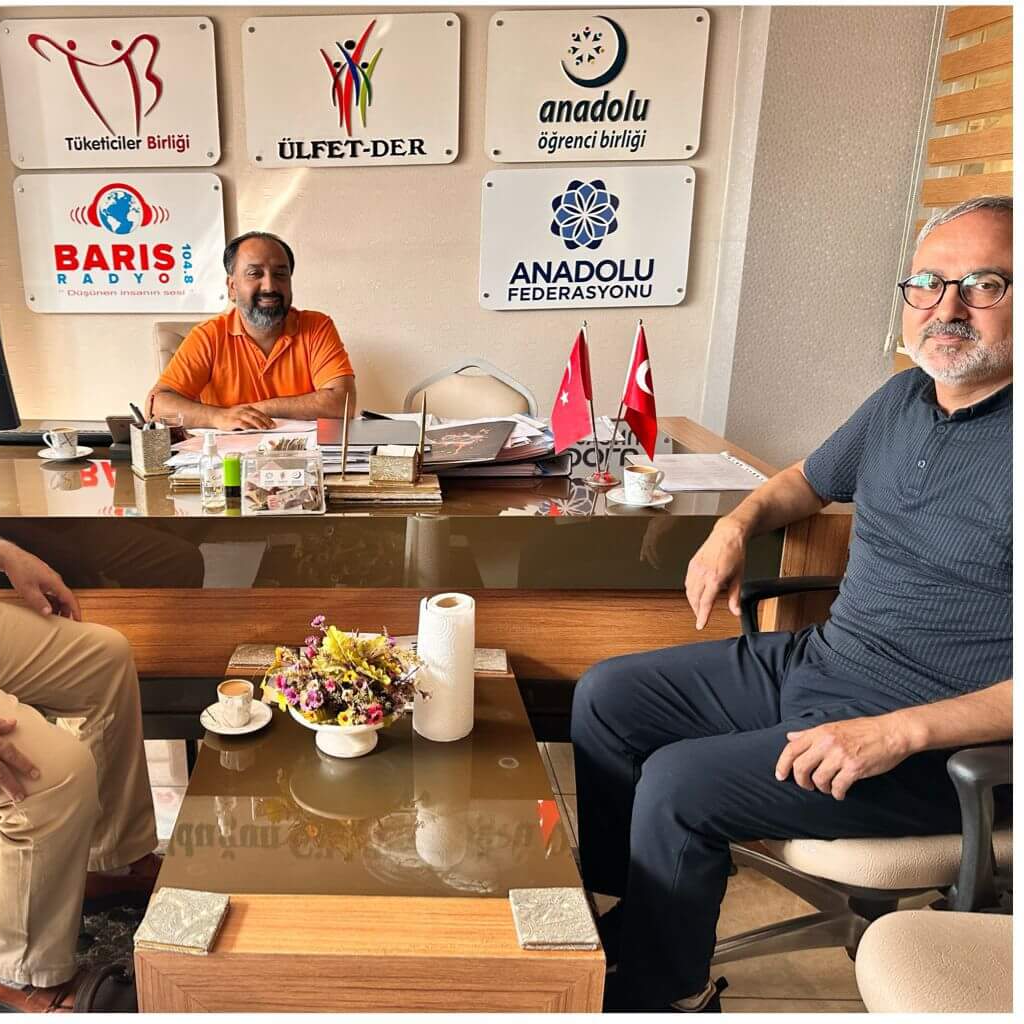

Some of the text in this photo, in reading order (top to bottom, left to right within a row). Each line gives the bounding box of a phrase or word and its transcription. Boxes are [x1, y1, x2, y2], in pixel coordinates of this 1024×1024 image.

[539, 90, 650, 122] anadolu
[65, 134, 190, 153] Tüketiciler Birliği
[278, 138, 426, 160] ÜLFET-DER
[538, 130, 647, 154] öğrenci birliği
[182, 243, 194, 283] 104.8
[509, 258, 655, 285] ANADOLU
[57, 273, 170, 284] RADYO
[508, 284, 653, 302] FEDERASYONU
